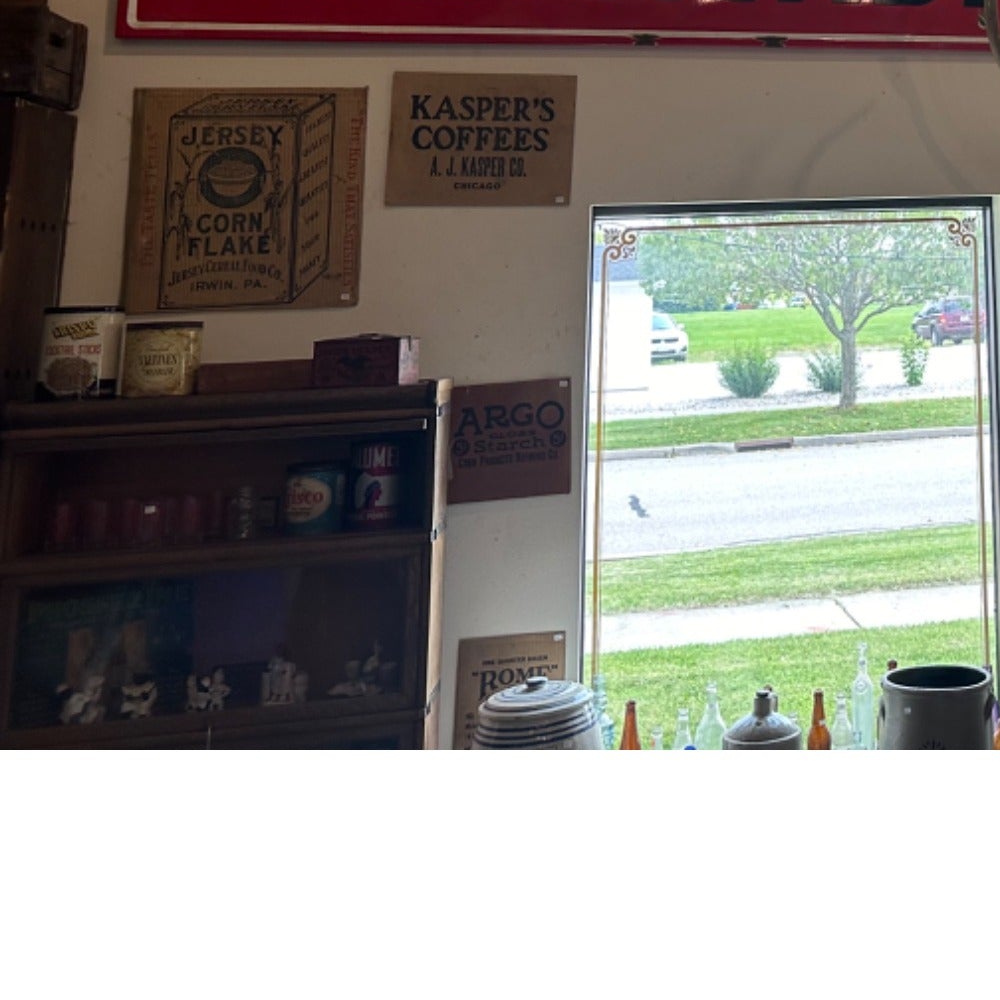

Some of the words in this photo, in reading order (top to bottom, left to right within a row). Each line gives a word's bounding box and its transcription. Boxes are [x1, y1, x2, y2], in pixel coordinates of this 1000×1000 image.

[410, 95, 555, 122] KASPER'S
[181, 126, 283, 146] JERSEY
[412, 126, 550, 151] COFFEES
[430, 156, 441, 177] A.
[446, 157, 457, 178] J.
[460, 156, 505, 178] KASPER
[509, 157, 527, 178] CO.
[453, 181, 501, 190] CHICAGO
[196, 212, 263, 234] CORN
[188, 235, 270, 257] FLAKE
[454, 400, 565, 438] ARGO
[474, 437, 545, 453] Starch
